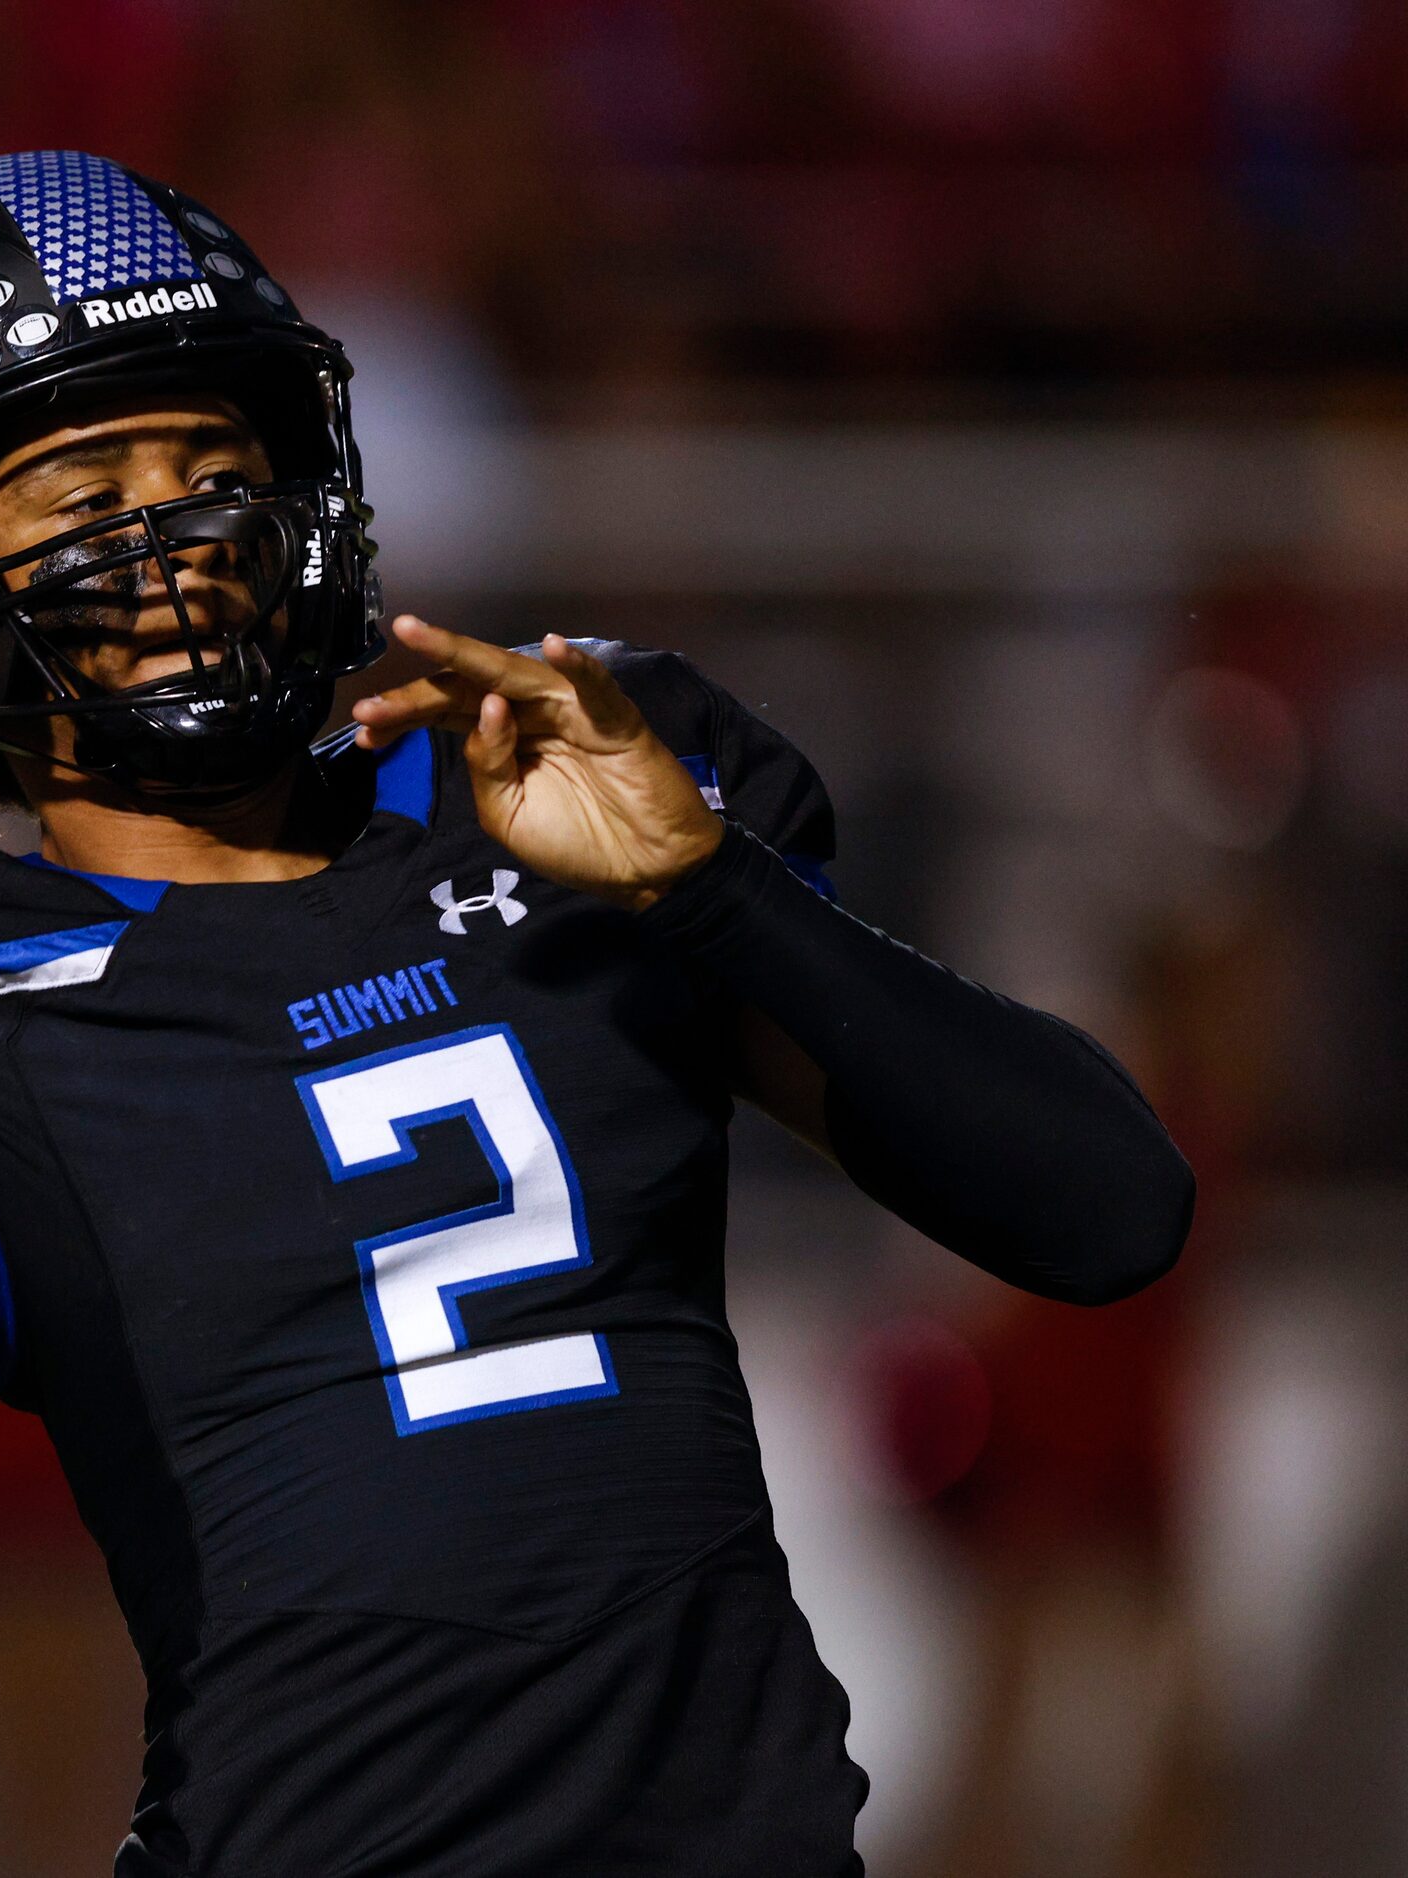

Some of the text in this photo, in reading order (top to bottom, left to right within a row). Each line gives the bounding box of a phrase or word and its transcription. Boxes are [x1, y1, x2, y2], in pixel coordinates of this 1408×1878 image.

[80, 282, 218, 329] Riddell
[287, 957, 460, 1050] SUMMIT
[294, 1022, 620, 1438] 2
